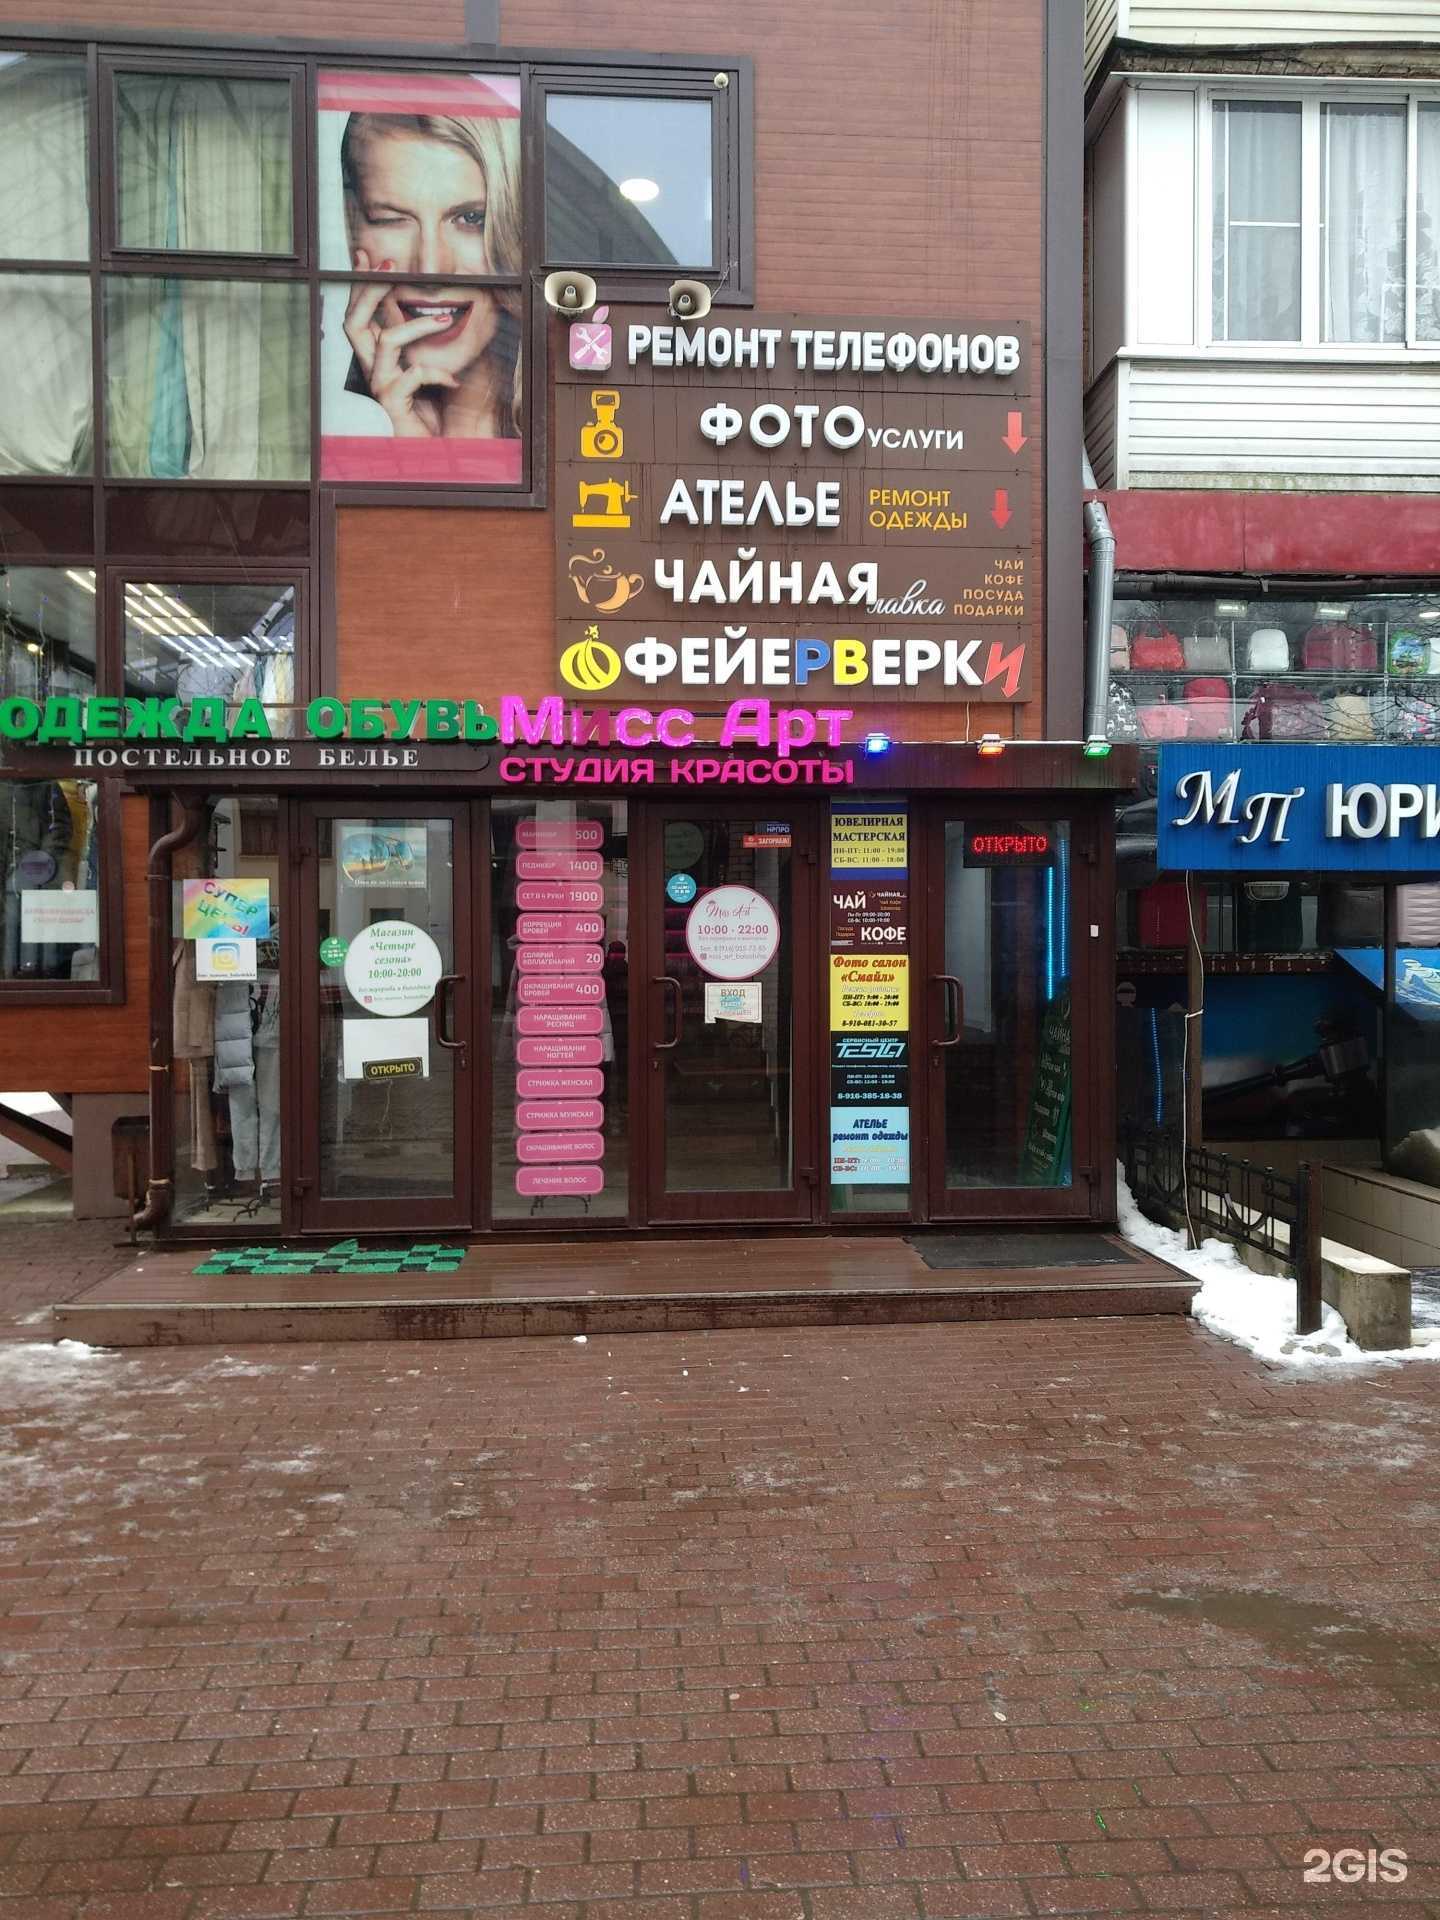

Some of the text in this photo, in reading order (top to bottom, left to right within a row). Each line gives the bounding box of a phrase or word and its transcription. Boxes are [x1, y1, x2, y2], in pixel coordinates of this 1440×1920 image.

[628, 325, 1020, 376] РЕМОНТ ТЕЛЕФОНОВ
[699, 403, 963, 450] ФОТО УСЛУГИ
[659, 478, 840, 528] АТЕЛЬЕ
[869, 489, 951, 507] РЕМОНТ
[869, 510, 968, 529] ОДЕЖДЫ
[654, 547, 945, 615] ЧАЙНАЯ лавка
[984, 574, 1024, 585] КОФЕ
[963, 588, 1024, 601] ПОСУДА
[954, 604, 1024, 616] ПОДАРКИ
[624, 625, 1026, 698] ФЕЙЕРВЕРКИ
[0, 697, 499, 744] ОДЕЖДА ОБУВЬ
[500, 695, 854, 757] Мисс Арт
[73, 748, 419, 768] ПОСТЕЛЬНОЕ БЕЛЬЕ
[500, 757, 854, 785] СТУДИЯ КРАСОТЫ
[835, 817, 903, 826] ЮВЕЛИРНАЯ
[833, 832, 905, 841] МАСТЕРСКАЯ
[971, 836, 1049, 852] ОТКРЫТО
[569, 861, 598, 871] 1400
[569, 892, 598, 902] 1900
[833, 891, 866, 909] ЧАЙ
[370, 928, 413, 937] Магазин
[576, 923, 599, 933] 400
[698, 925, 728, 934] 10:00
[738, 925, 769, 934] 22:00
[861, 926, 907, 941] КОФЕ
[586, 953, 600, 963] 20
[833, 956, 907, 968] Фото салон
[368, 968, 422, 979] 10:00-20:00
[841, 970, 895, 982] «Смайл»
[576, 984, 600, 994] 400
[721, 989, 745, 998] ВХОД
[371, 1063, 415, 1075] ОТКРЫТО
[853, 1119, 888, 1129] АТЕЛЬЕ
[833, 1131, 908, 1142] ремонт одежды
